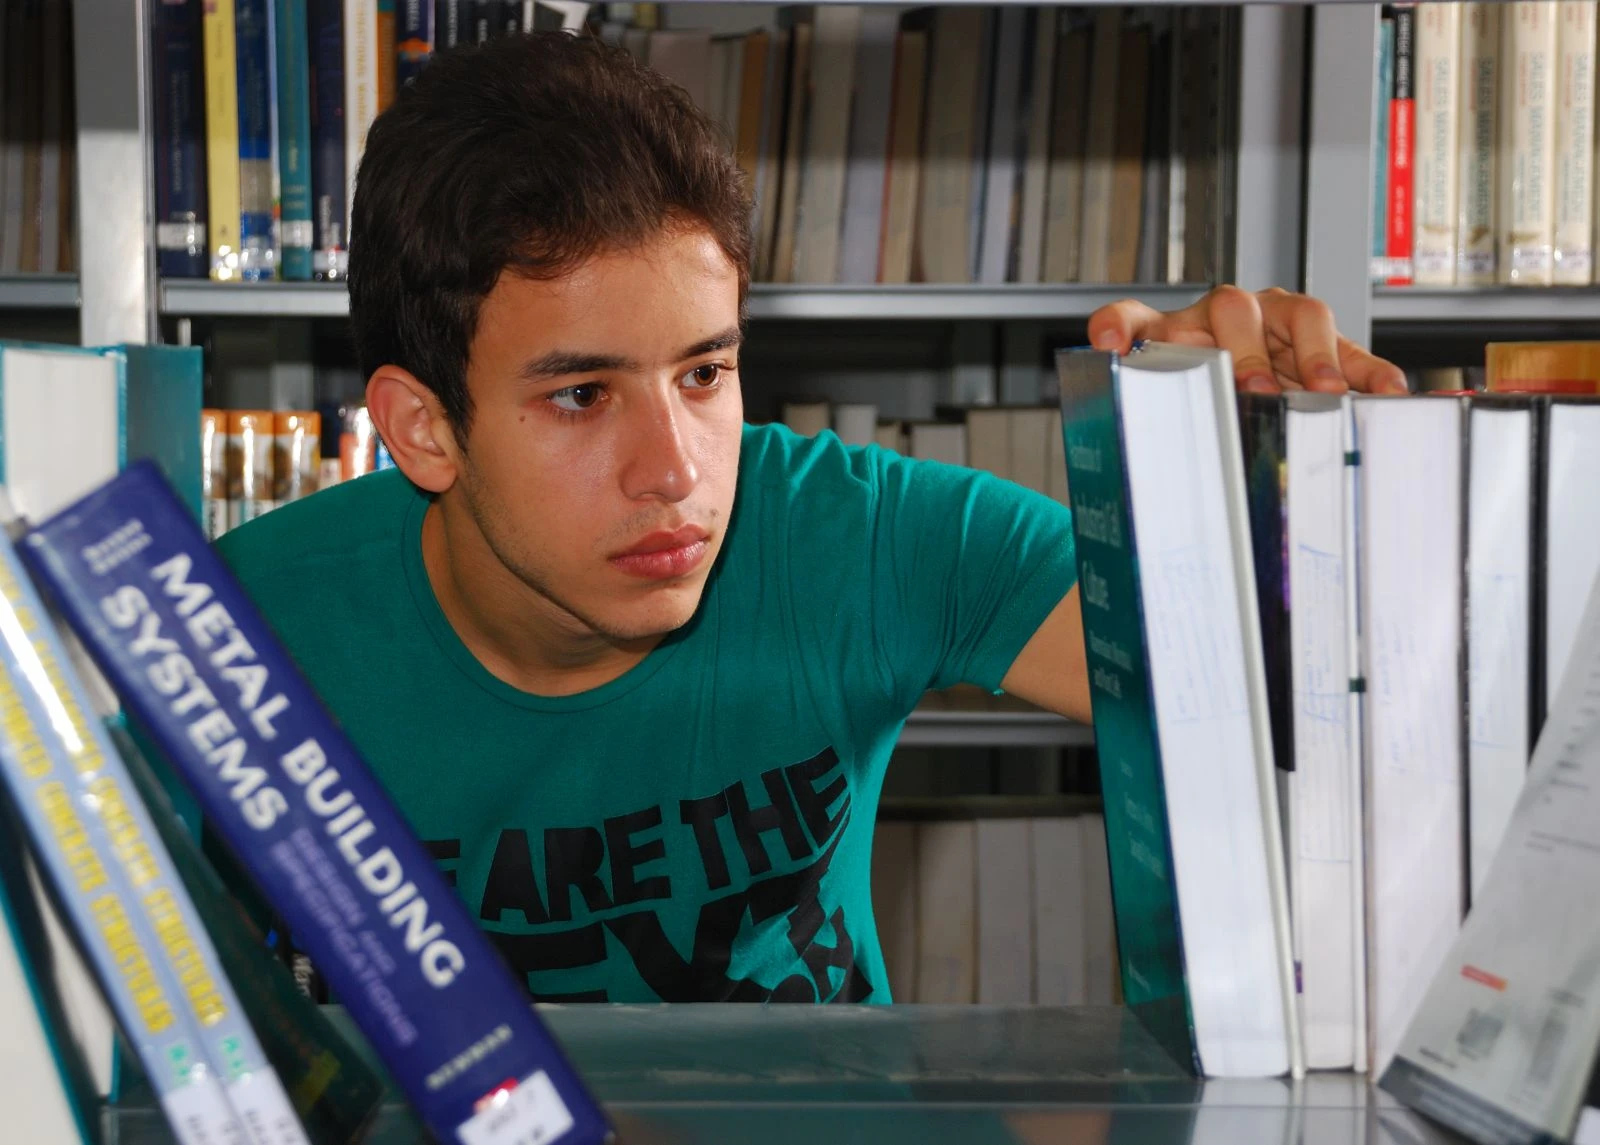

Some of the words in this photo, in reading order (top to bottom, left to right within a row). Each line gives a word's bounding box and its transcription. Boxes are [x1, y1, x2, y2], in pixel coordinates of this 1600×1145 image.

[101, 585, 289, 831] SYSTEMS
[150, 552, 290, 739] METAL
[279, 739, 466, 988] BUILDING
[291, 828, 367, 927] DESIGN
[480, 804, 672, 924] ARE
[679, 745, 851, 892] THE
[89, 892, 177, 1033] STRUCTURES
[143, 887, 229, 1029] STRUCTURES
